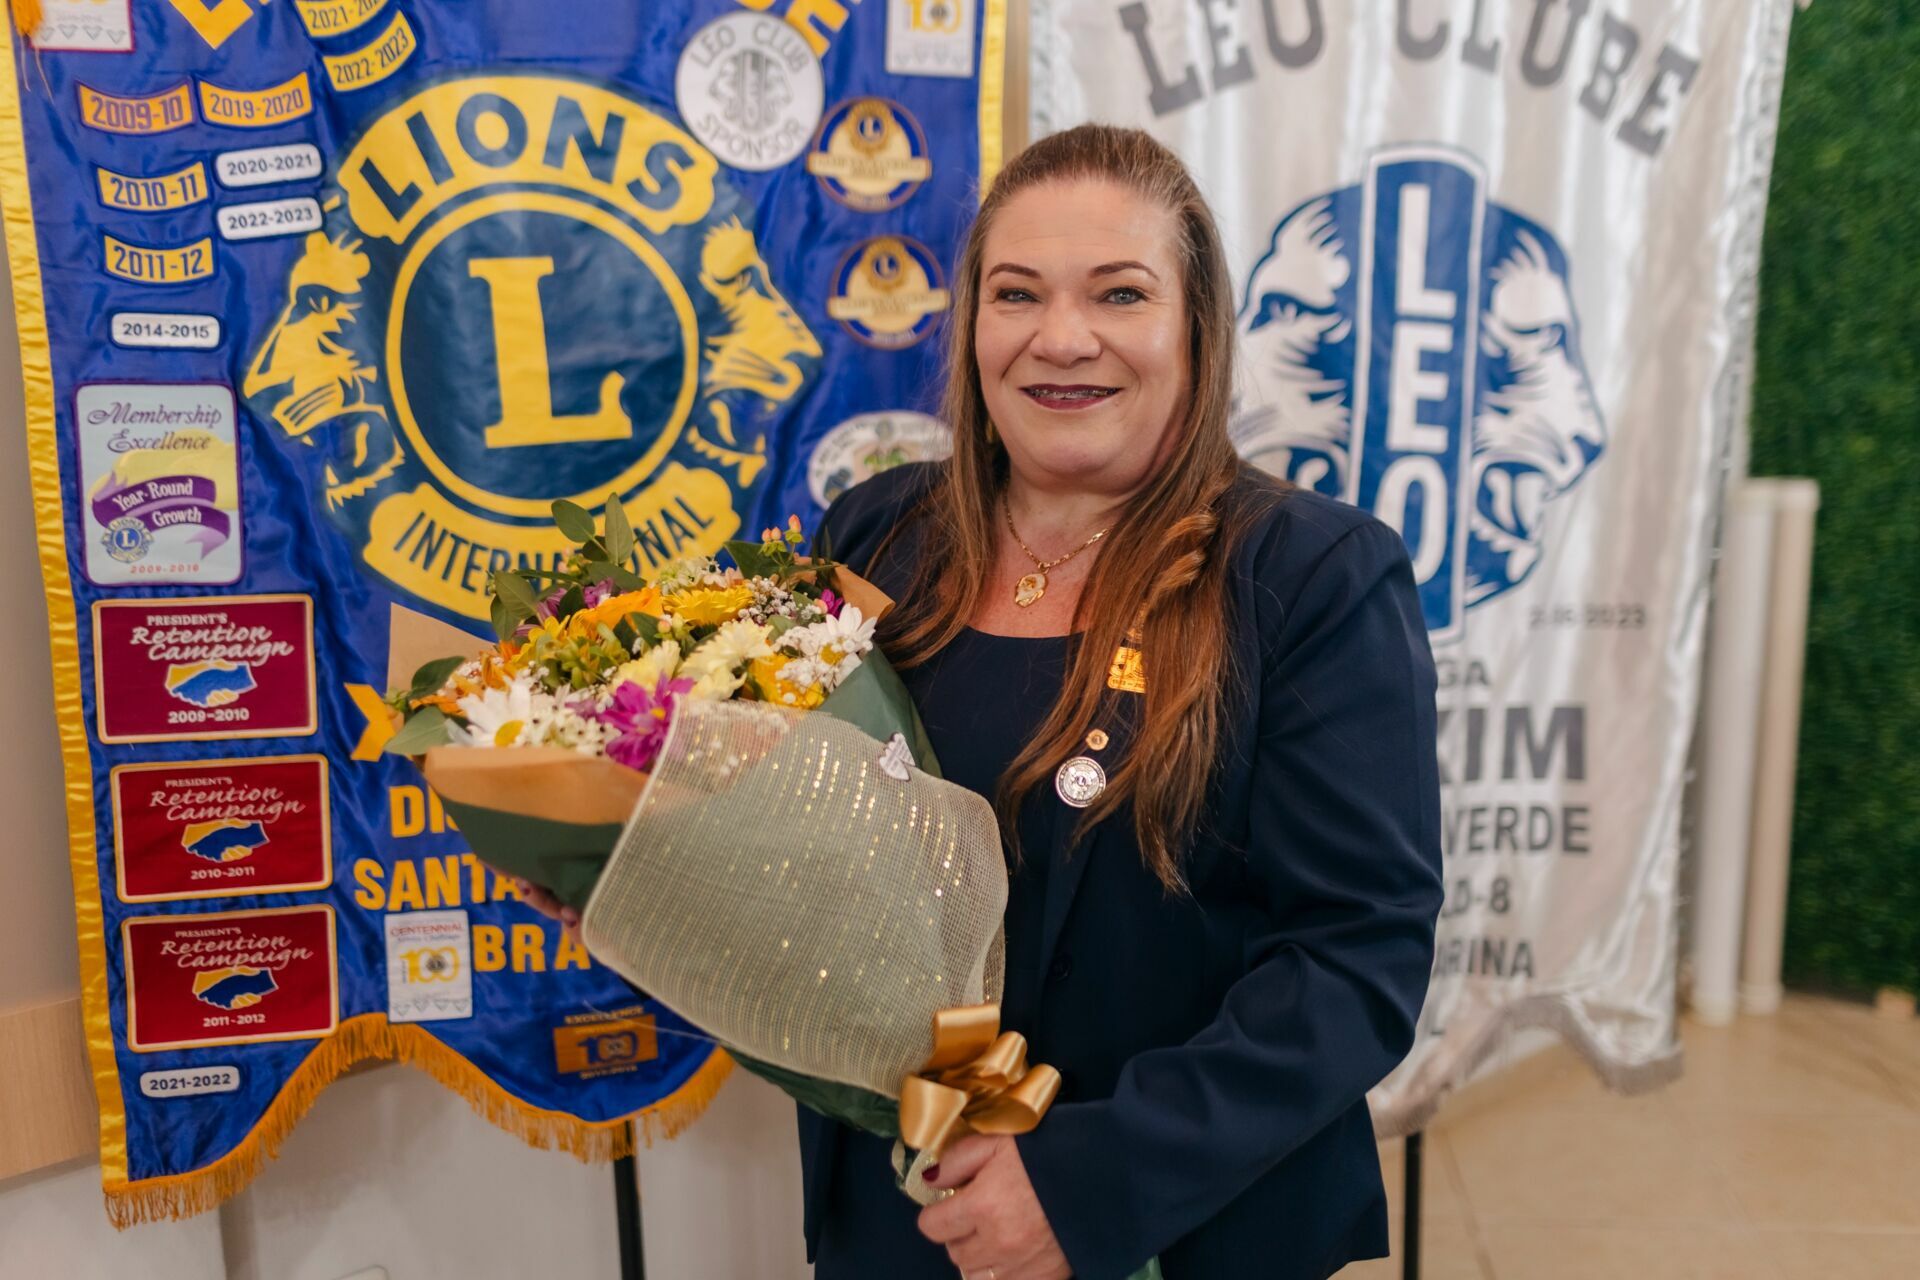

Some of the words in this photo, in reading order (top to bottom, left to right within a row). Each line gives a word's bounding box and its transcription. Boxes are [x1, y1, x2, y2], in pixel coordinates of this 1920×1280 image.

[308, 0, 379, 29] 2021-20
[333, 27, 410, 84] 2022-2023
[690, 24, 736, 69] LEO
[753, 20, 810, 74] CLUB
[91, 94, 184, 129] 2009-10
[210, 88, 304, 119] 2019-2020
[697, 114, 801, 161] SPONSOR
[227, 155, 313, 176] 2020-2021
[360, 92, 696, 222] LIONS
[110, 175, 198, 207] 2010-11
[228, 207, 313, 230] 2022-2023
[113, 246, 205, 280] 2011-12
[122, 322, 210, 339] 2014-2015
[468, 256, 633, 448] L
[87, 402, 222, 428] Membership
[107, 429, 210, 454] Excellence
[152, 507, 202, 527] Growth
[147, 613, 228, 626] PRESIDENT'S
[130, 622, 272, 645] Retention
[148, 641, 295, 667] Campaign
[168, 708, 250, 724] 2009-2010
[165, 777, 233, 788] PRESIDENT'S
[150, 784, 283, 807] Retention
[166, 799, 306, 824] Campaign
[190, 866, 255, 880] 2010-2011
[175, 927, 242, 939] PRESIDENT'S
[390, 922, 463, 937] CENTENNIAL
[160, 934, 292, 956] Retention
[177, 948, 314, 971] Campaign
[203, 1014, 266, 1028] 2011-2012
[150, 1073, 231, 1091] 2021-2022
